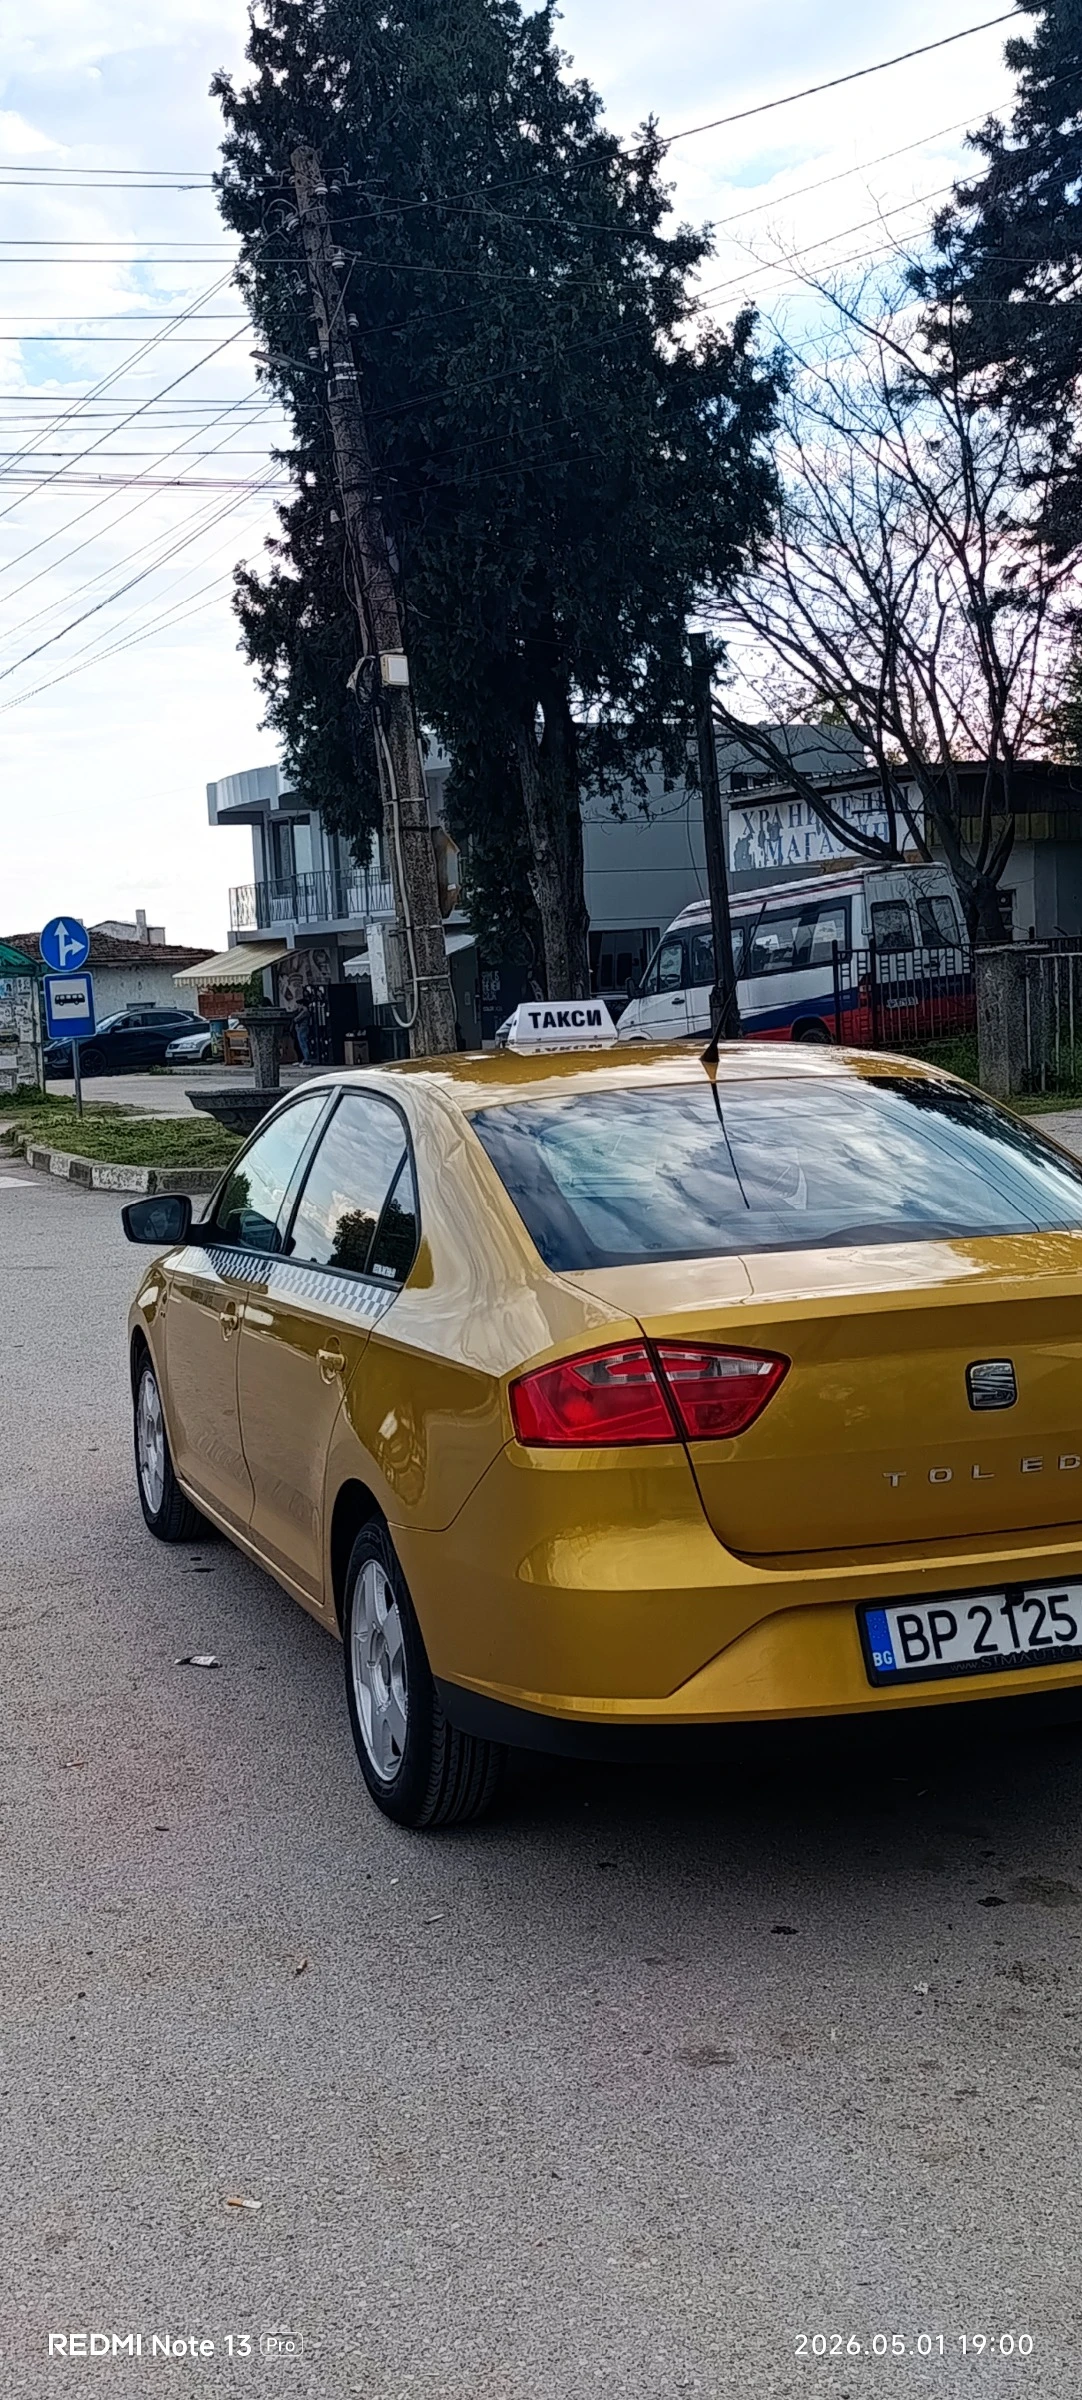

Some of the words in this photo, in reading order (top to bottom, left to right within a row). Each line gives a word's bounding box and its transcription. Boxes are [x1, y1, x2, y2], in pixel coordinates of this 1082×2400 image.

[528, 1009, 603, 1029] ТАКСИ
[883, 1454, 1081, 1487] TOLED
[896, 1609, 958, 1663] BP
[967, 1594, 1078, 1654] 2125
[873, 1651, 893, 1666] BG
